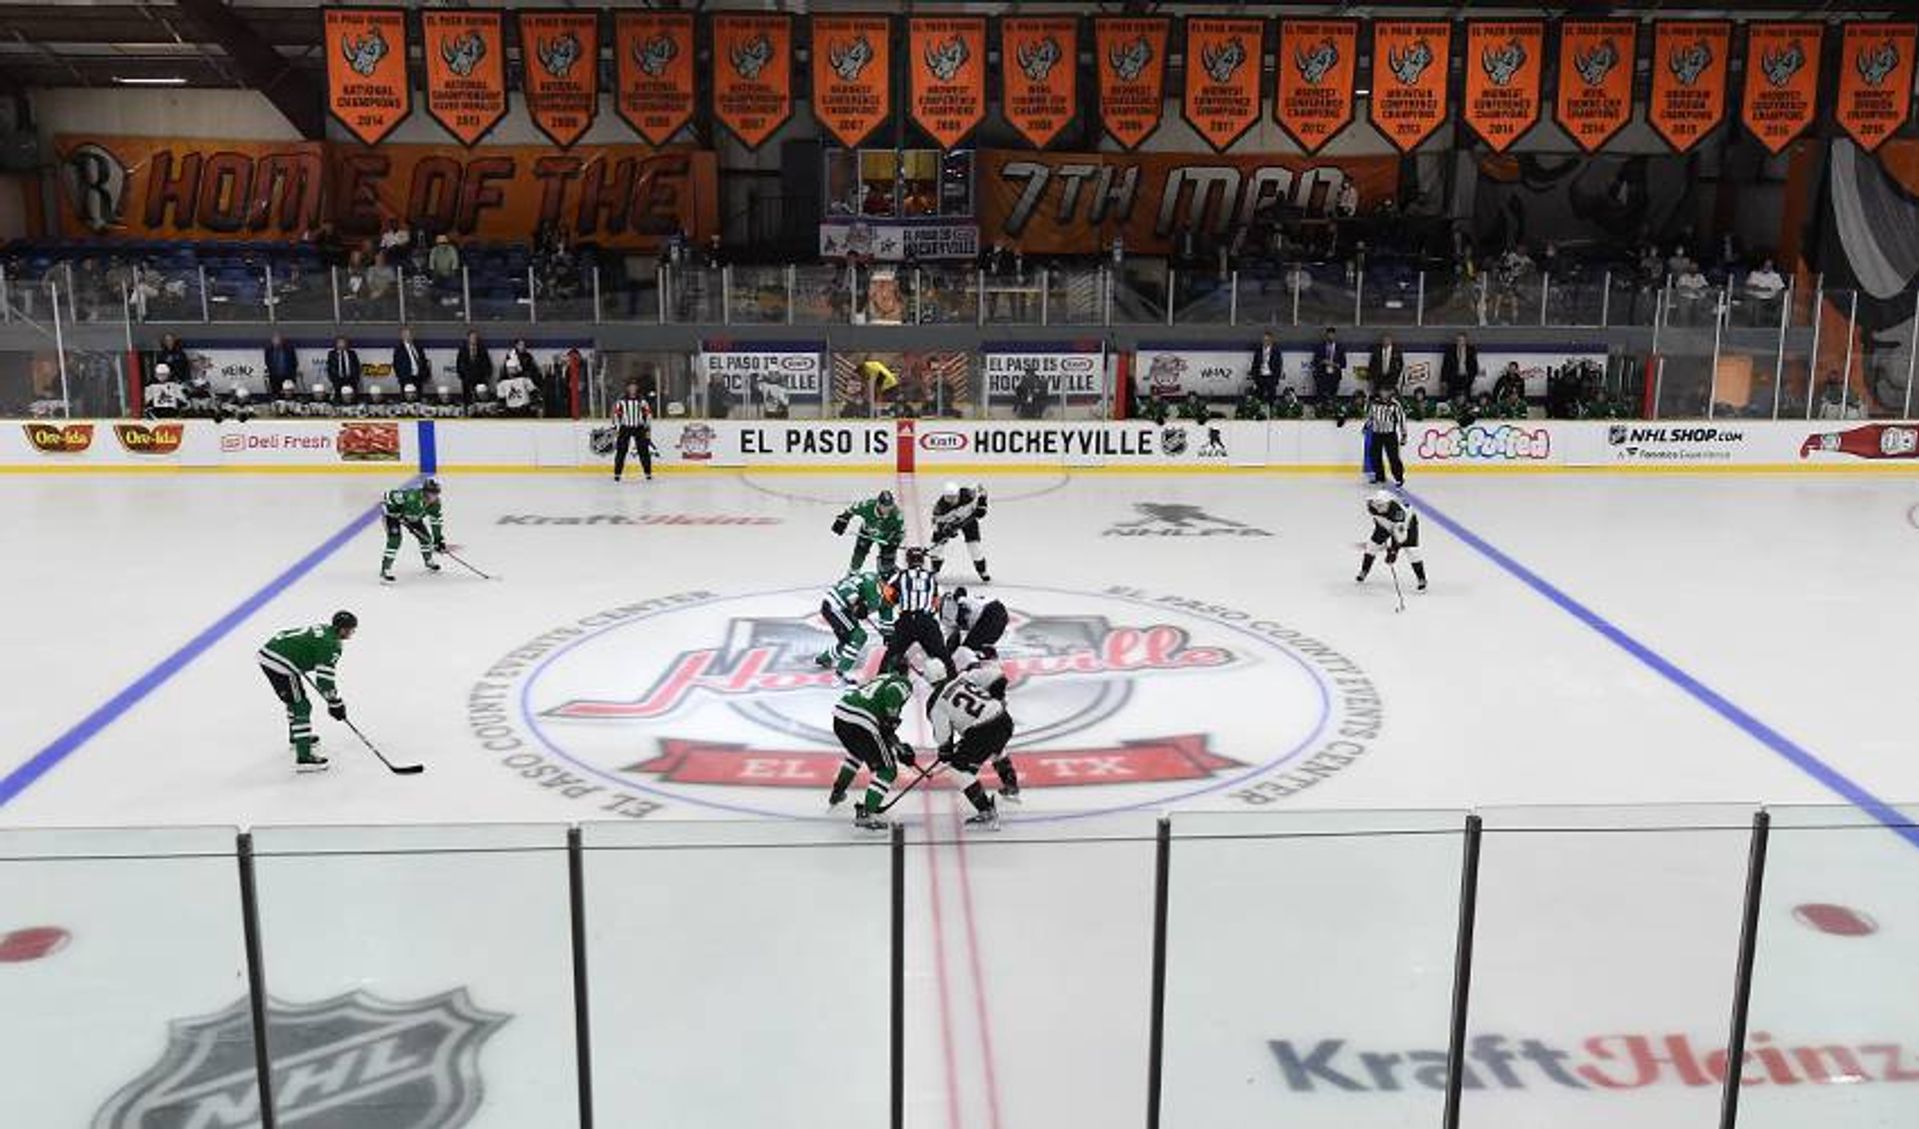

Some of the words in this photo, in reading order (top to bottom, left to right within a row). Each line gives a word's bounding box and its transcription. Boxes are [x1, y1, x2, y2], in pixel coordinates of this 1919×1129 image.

[144, 149, 392, 231] HOME
[406, 155, 515, 235] OF
[533, 153, 690, 235] THE
[1001, 162, 1140, 237] 7TH
[709, 357, 723, 370] EL
[727, 357, 760, 370] PASO
[990, 357, 1003, 371] EL
[1007, 357, 1040, 371] PASO
[1044, 357, 1058, 371] IS
[35, 430, 88, 446] Ore-Ida
[126, 430, 178, 446] Ore-Ida
[248, 434, 279, 450] Deli
[284, 434, 331, 450] Fresh
[740, 430, 773, 454] EL
[786, 430, 852, 454] PASO
[865, 430, 889, 454] IS
[929, 434, 958, 447] Kraft
[974, 430, 1154, 455] HOCKEYVILLE
[1418, 425, 1550, 459] Jet-Puffed
[1250, 619, 1364, 676] COUNTY
[468, 681, 522, 751] COUNTY
[501, 754, 607, 800] PASO
[740, 757, 814, 779] EL
[1039, 755, 1135, 777] TX
[1225, 740, 1366, 806] CENTER
[599, 793, 664, 819] EL
[184, 1039, 422, 1129] NHL
